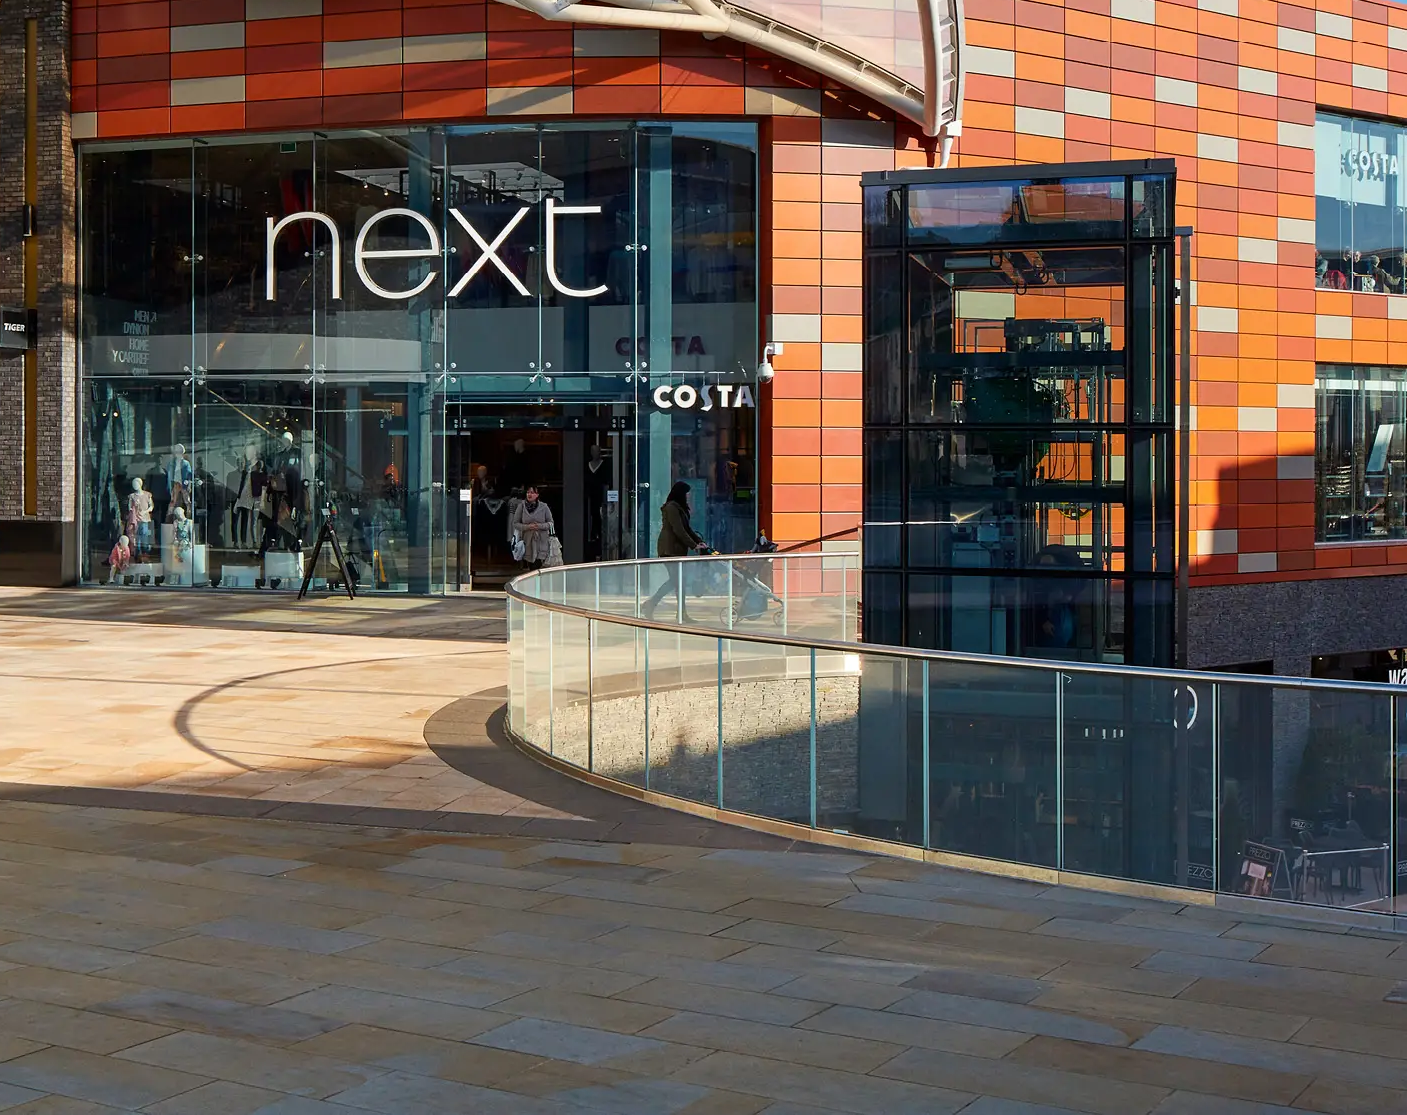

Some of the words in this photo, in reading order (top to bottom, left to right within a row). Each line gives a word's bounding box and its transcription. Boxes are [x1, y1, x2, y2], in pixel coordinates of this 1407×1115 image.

[1347, 149, 1398, 175] COSTA
[266, 198, 608, 301] next
[134, 310, 149, 322] MEN
[4, 322, 26, 332] TIGER
[129, 338, 149, 351] HOME
[654, 385, 755, 411] COSTA
[1249, 846, 1271, 860] PREZZO
[1187, 865, 1214, 879] EZZO
